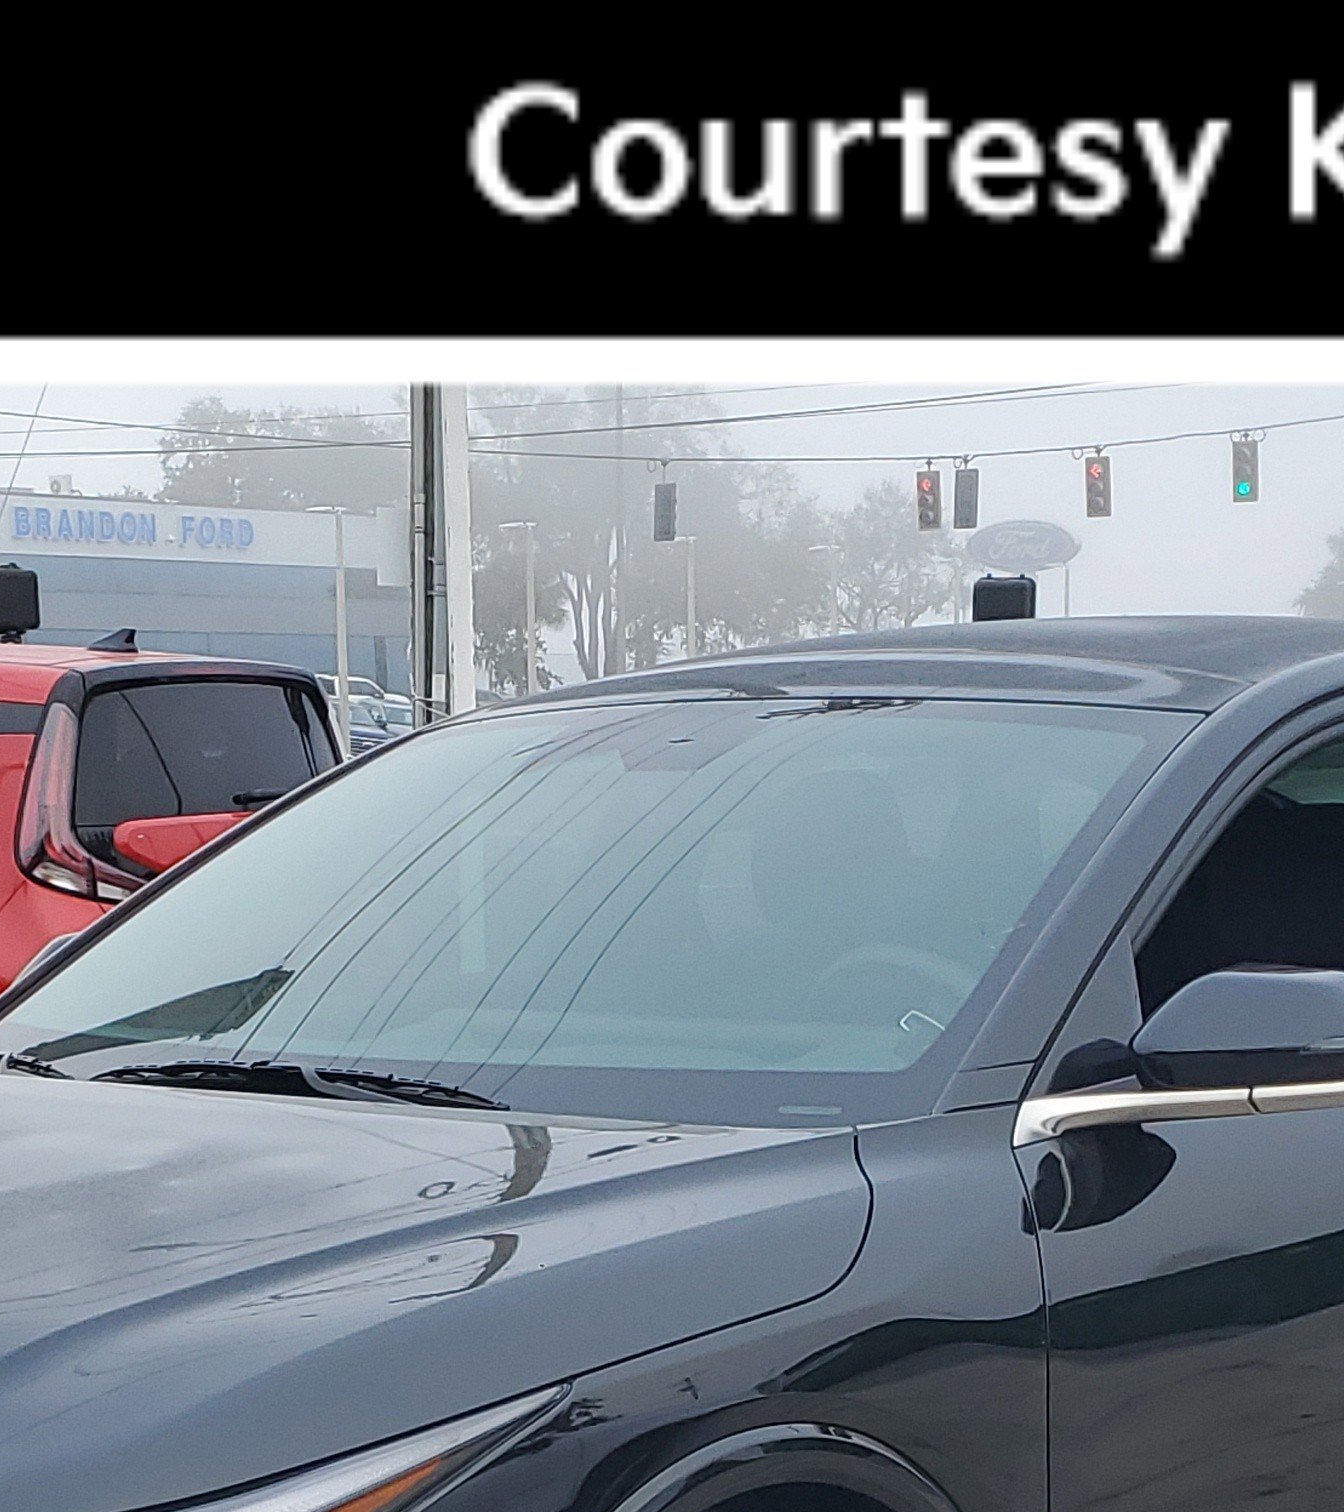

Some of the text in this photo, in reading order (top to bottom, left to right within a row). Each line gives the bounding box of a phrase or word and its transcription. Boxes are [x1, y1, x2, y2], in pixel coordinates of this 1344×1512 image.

[14, 506, 254, 547] BRANDON FORD
[989, 530, 1052, 560] Ford
